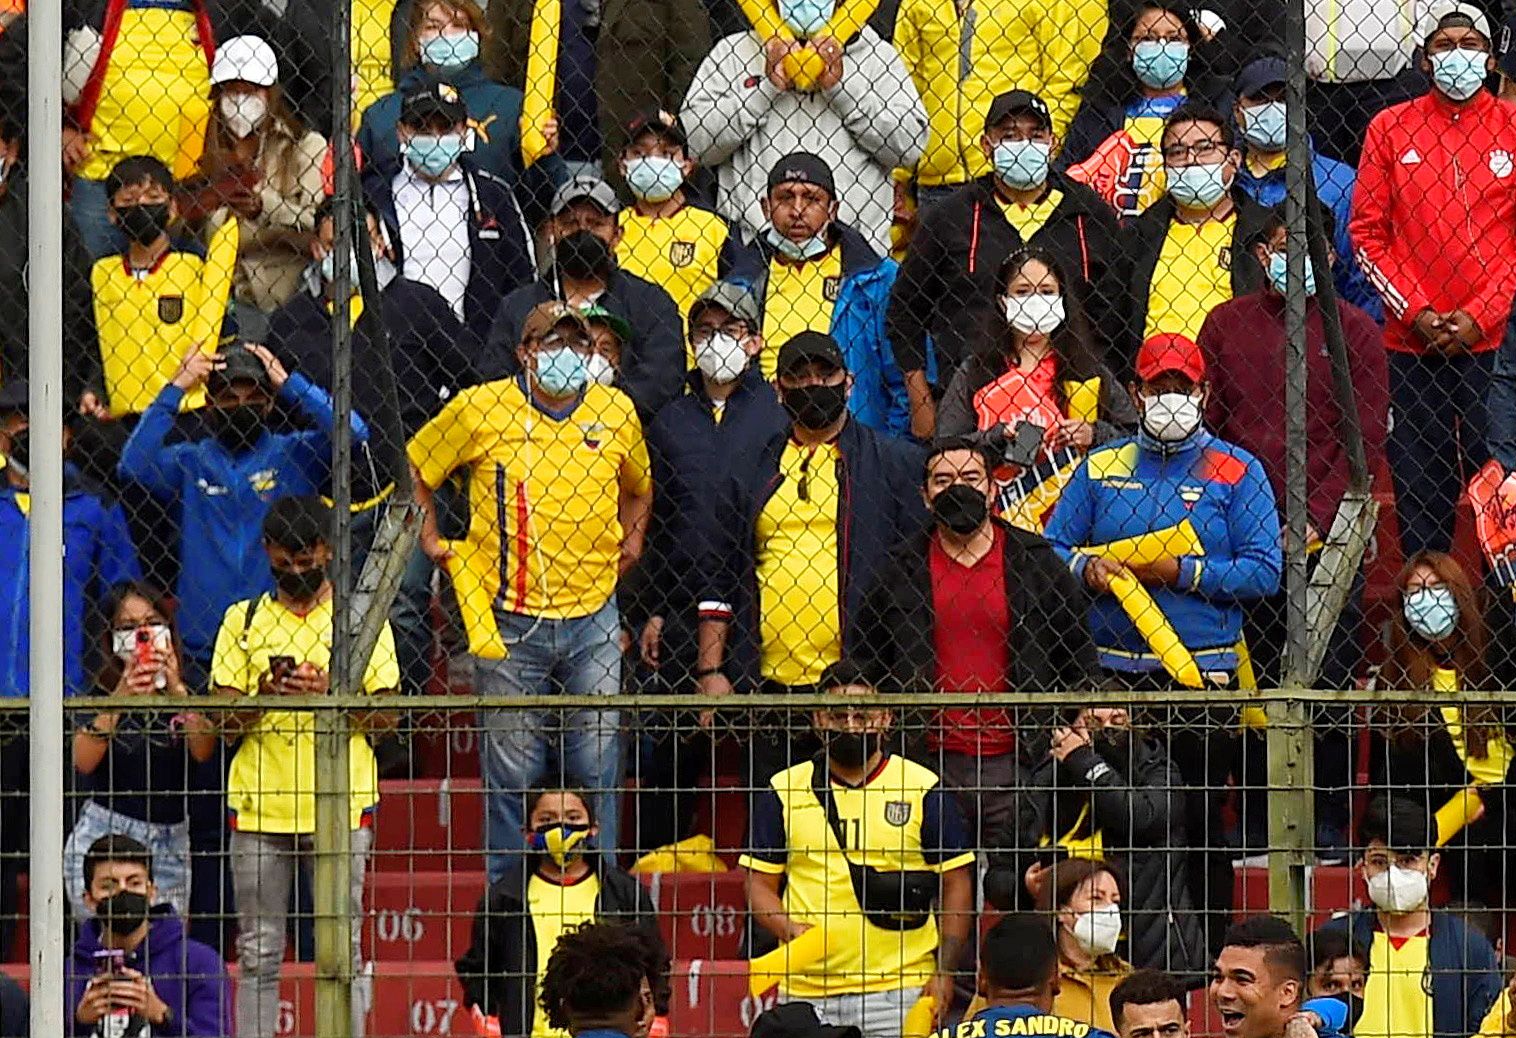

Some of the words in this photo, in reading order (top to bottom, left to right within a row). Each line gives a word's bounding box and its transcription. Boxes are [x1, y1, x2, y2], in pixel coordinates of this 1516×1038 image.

[377, 907, 424, 942] 06
[691, 904, 737, 937] 08
[412, 999, 459, 1034] 07
